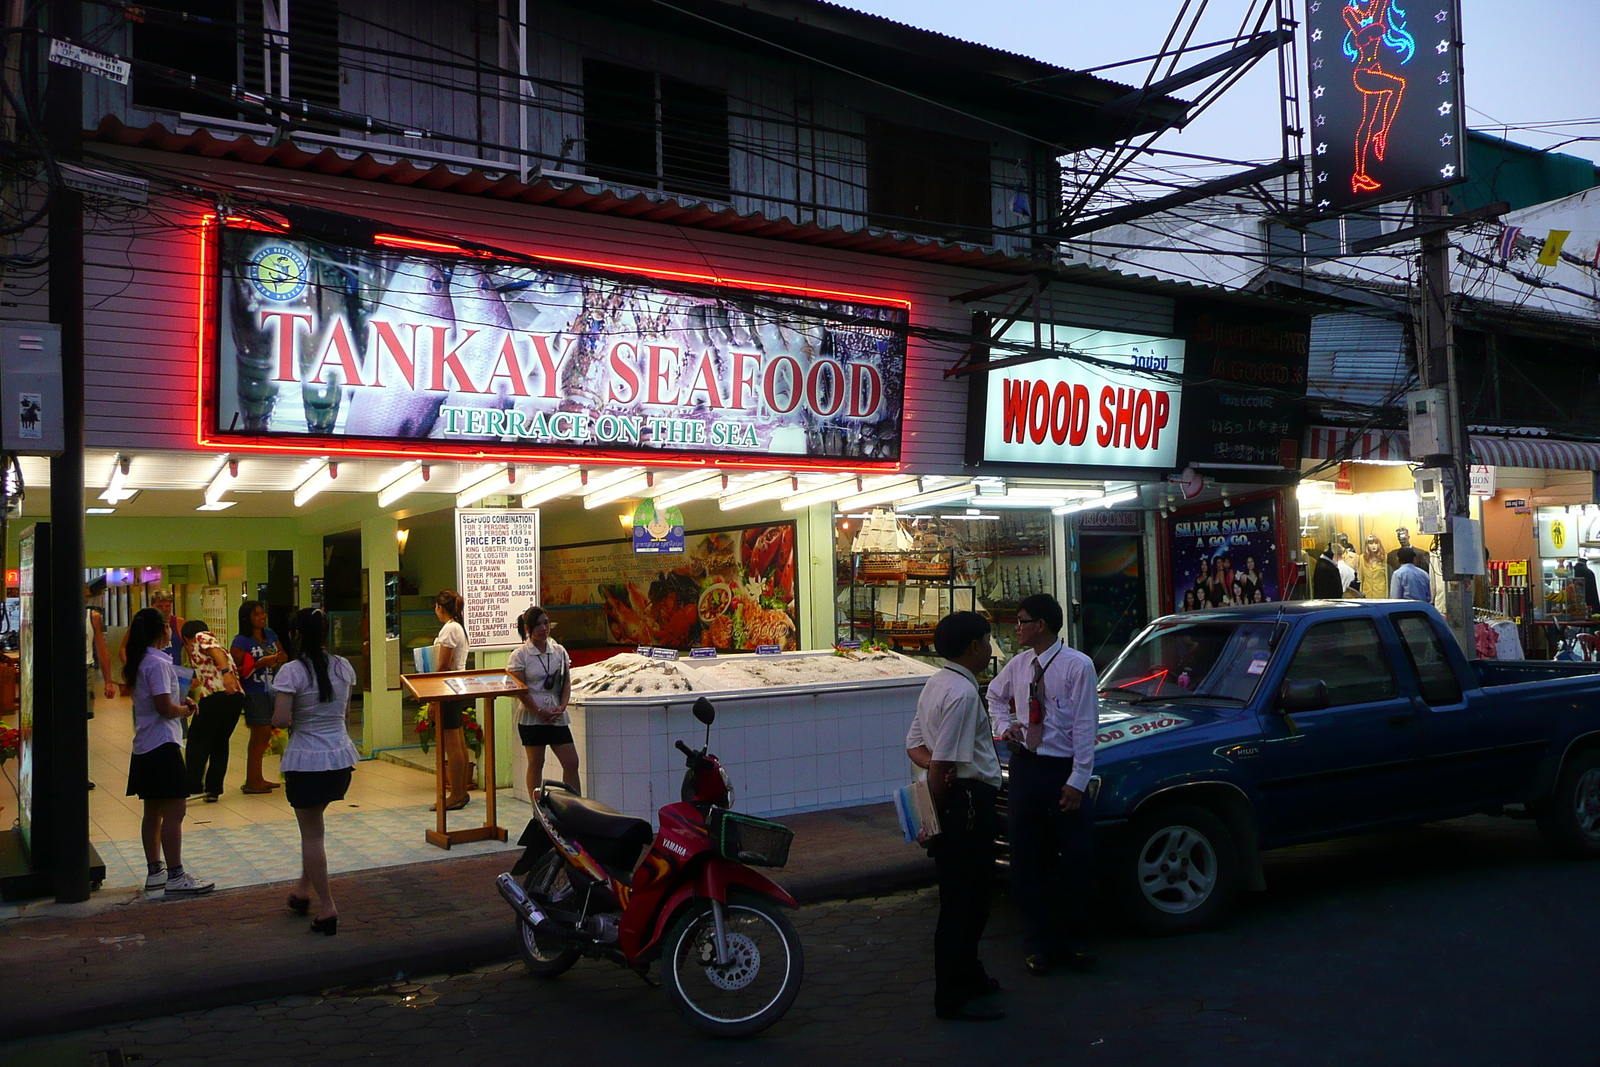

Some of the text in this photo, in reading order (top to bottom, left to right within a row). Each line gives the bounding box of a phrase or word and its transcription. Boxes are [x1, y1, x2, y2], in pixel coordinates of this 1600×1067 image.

[261, 310, 882, 418] TANKAY SEAFOOD
[1003, 378, 1170, 450] WOOD SHOP
[441, 407, 759, 447] TERRACE ON THE SEA
[462, 515, 533, 524] SEAFOOD COMBINATION
[1175, 515, 1270, 538] SILVER STAR 3
[465, 536, 489, 545] PRICE
[491, 536, 507, 545] PER
[508, 536, 523, 544] 100
[1195, 534, 1247, 548] A GO GO
[1237, 747, 1260, 756] HILUX
[662, 838, 687, 857] YAMAHA
